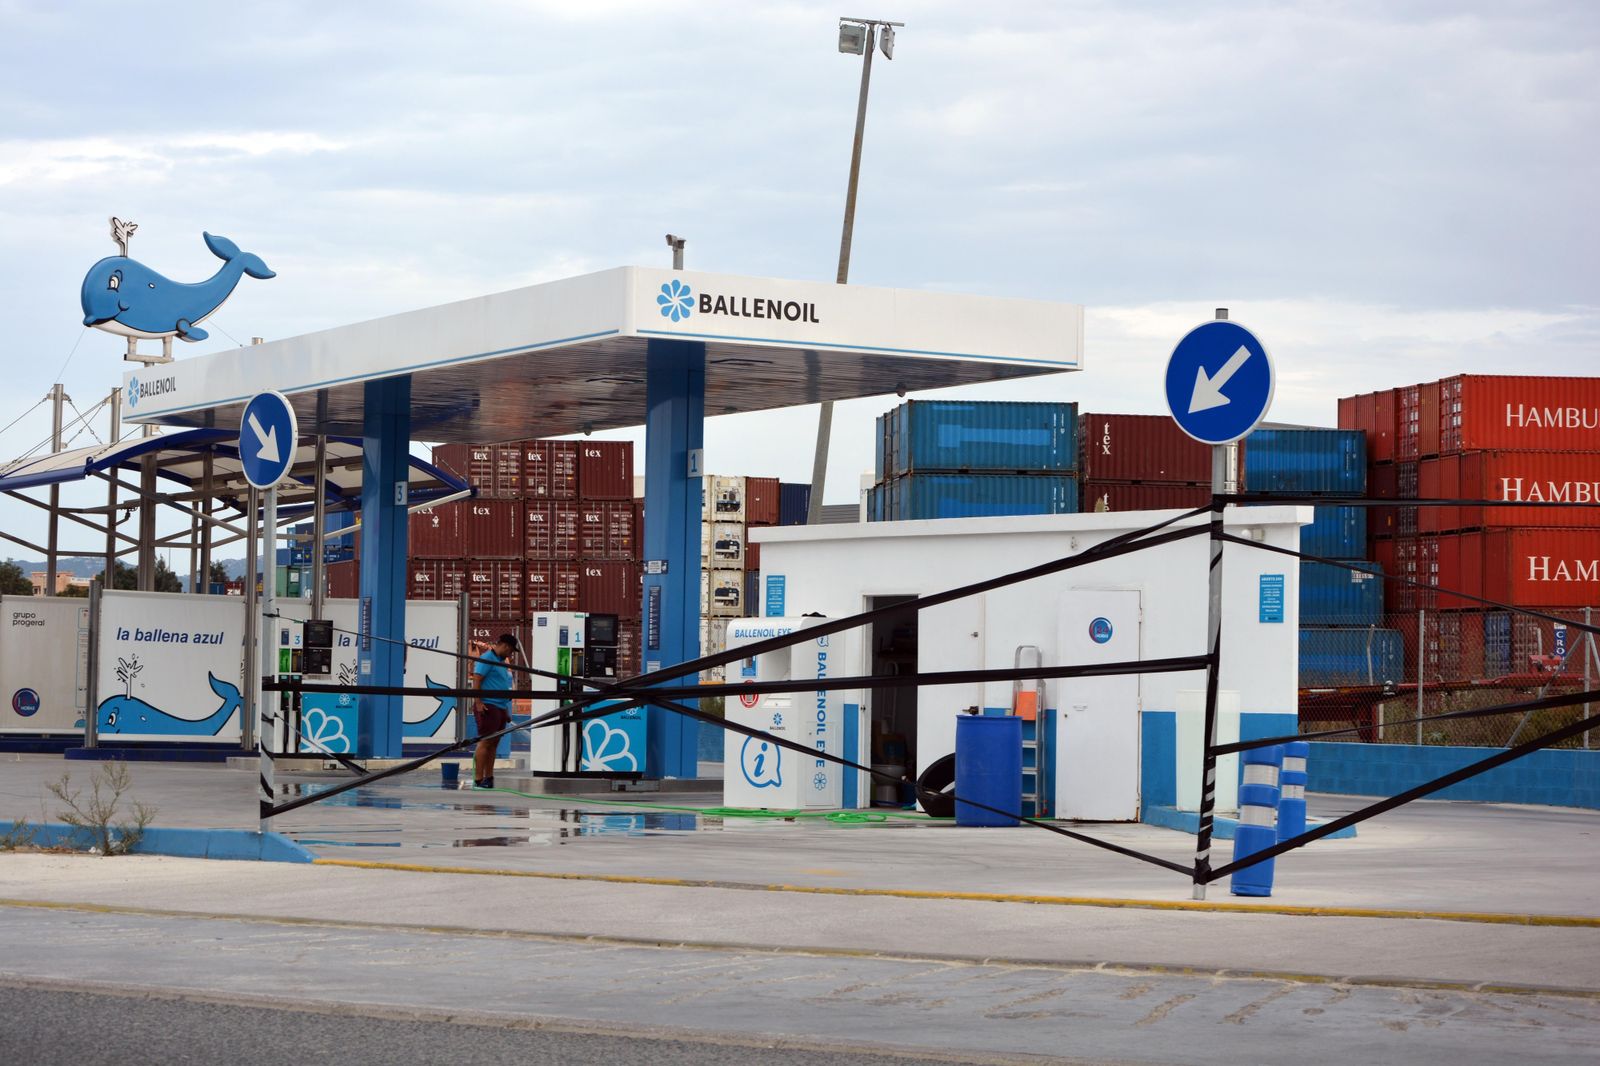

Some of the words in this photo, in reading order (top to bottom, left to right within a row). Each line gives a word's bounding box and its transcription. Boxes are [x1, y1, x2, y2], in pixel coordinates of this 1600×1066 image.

[699, 293, 819, 323] BALLENOIL
[140, 376, 176, 398] BALLENOIL
[1102, 422, 1111, 455] tex
[474, 451, 488, 461] tex
[528, 452, 542, 461] tex
[585, 448, 601, 458] tex
[691, 452, 698, 472] 1
[397, 486, 403, 502] 3
[473, 506, 490, 515] tex
[529, 513, 544, 522] tex
[585, 513, 600, 522] tex
[585, 567, 602, 577] tex
[1527, 556, 1599, 581] HAM
[415, 573, 430, 582] tex
[472, 573, 487, 582] tex
[530, 574, 544, 582] tex
[12, 611, 36, 620] grupo
[12, 619, 45, 628] progeral
[116, 627, 130, 641] la
[134, 628, 188, 644] ballena
[193, 631, 224, 645] azul
[473, 628, 491, 637] tex
[575, 632, 581, 642] 1
[735, 628, 775, 638] BALLENOIL
[294, 635, 301, 645] 3
[338, 634, 351, 647] la
[410, 636, 439, 649] azul
[816, 652, 827, 735] BALENOIL
